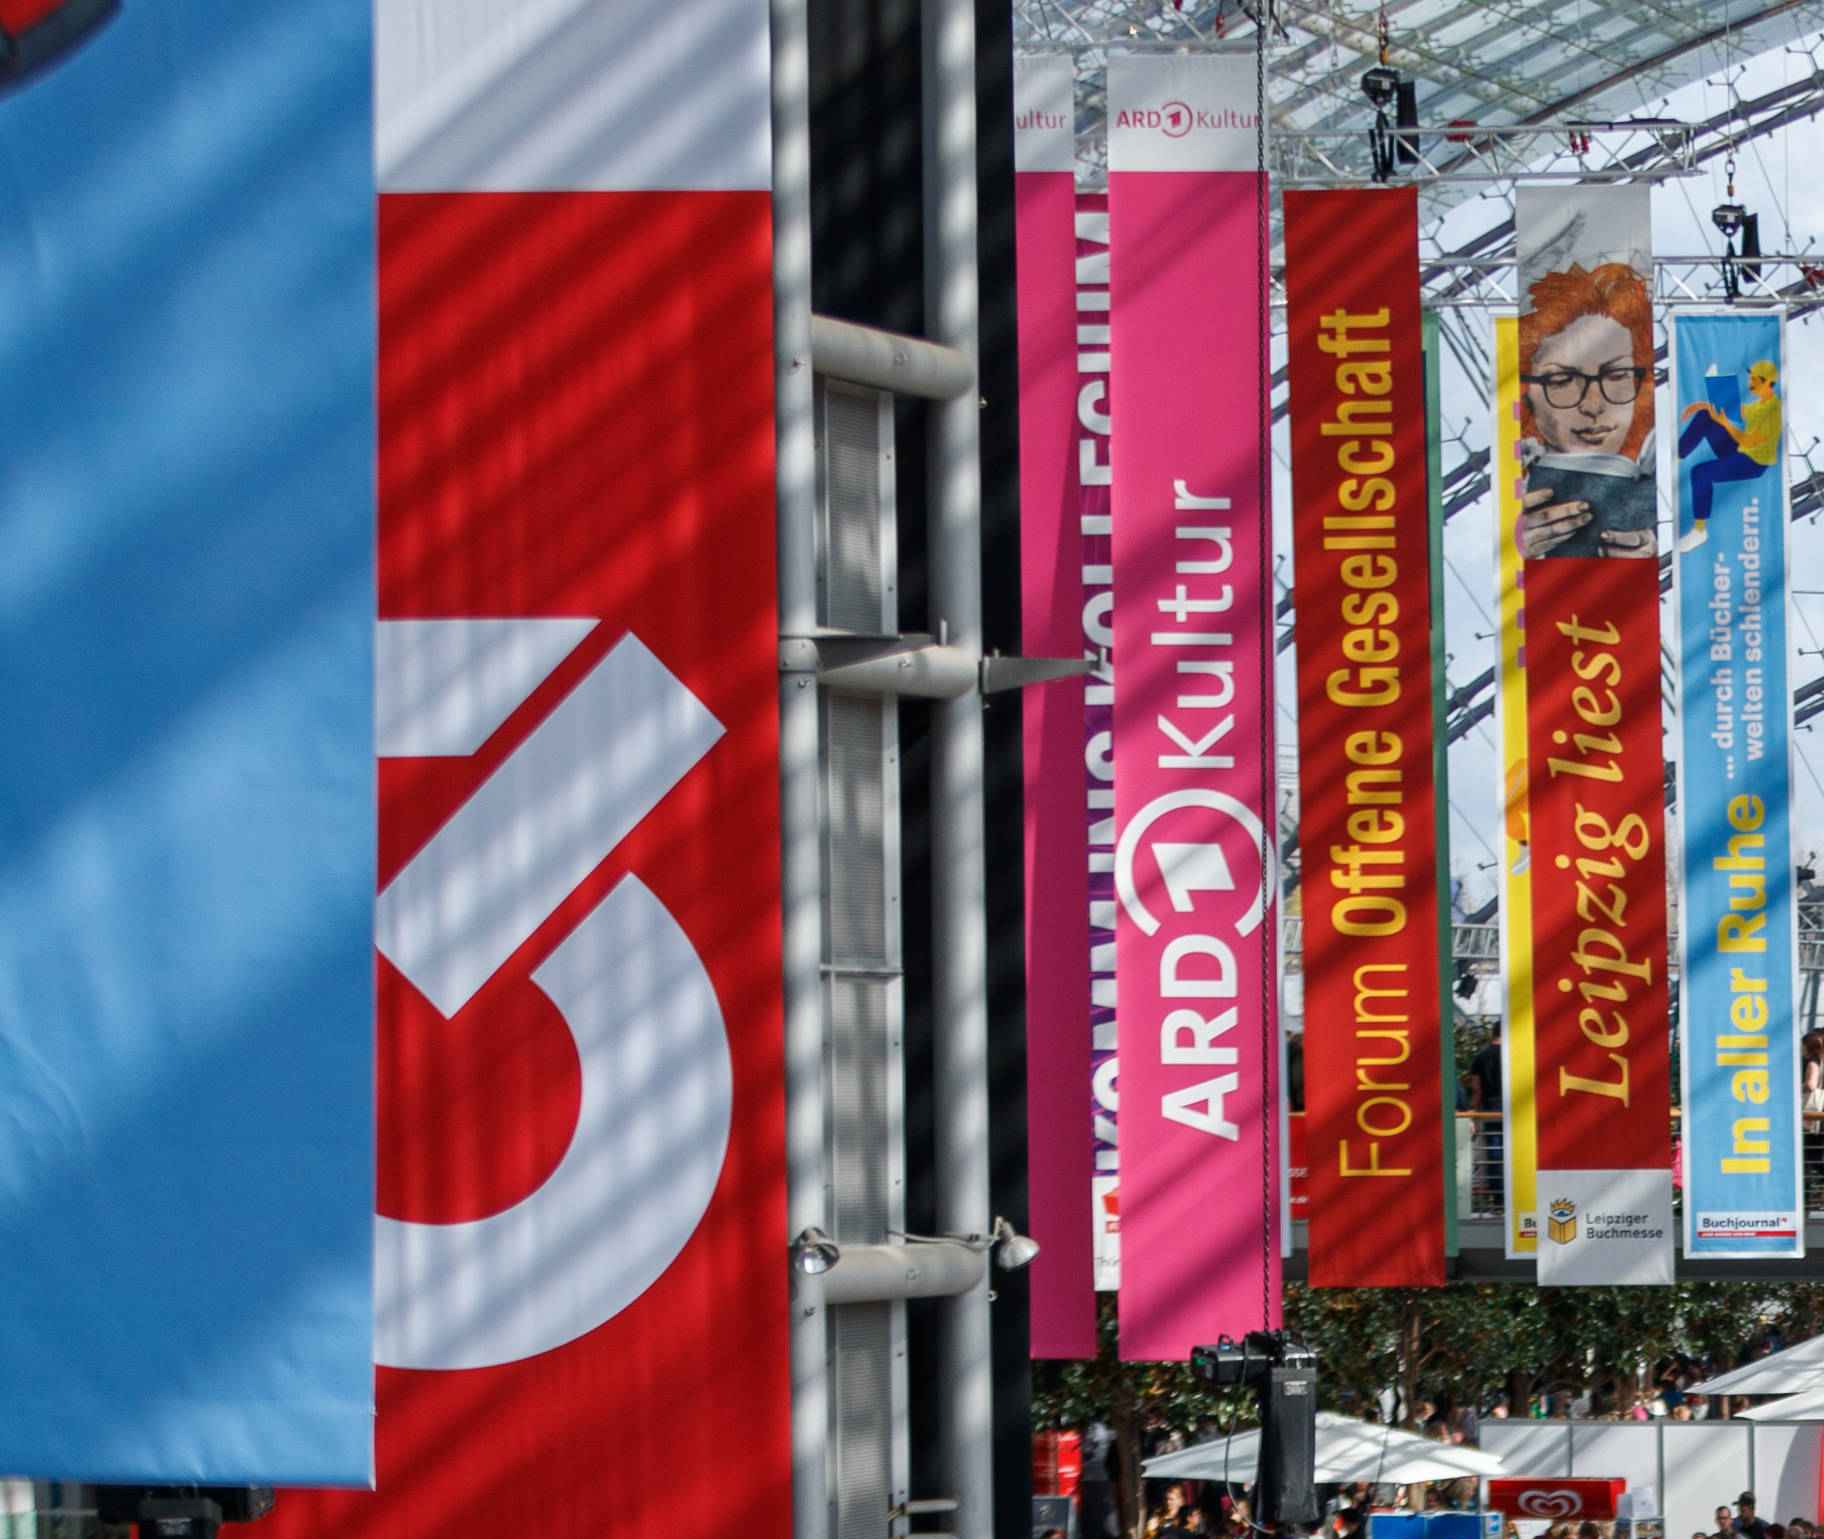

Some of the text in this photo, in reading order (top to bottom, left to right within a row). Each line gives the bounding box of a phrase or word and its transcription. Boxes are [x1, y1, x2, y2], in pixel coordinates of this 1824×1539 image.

[1016, 108, 1067, 130] ultur
[1115, 108, 1161, 130] ARD
[1197, 108, 1263, 130] Kultur
[1153, 480, 1236, 768] Kultur
[1710, 551, 1734, 662] Bücher-
[1737, 497, 1764, 761] welten schlendern.
[1317, 307, 1413, 1177] Forum Offene Gesellschaft
[1710, 668, 1735, 748] durch
[1546, 613, 1652, 1108] Leipzig liest
[1712, 793, 1767, 953] Ruhe
[1160, 934, 1239, 1142] ARD
[1716, 967, 1770, 1104] aller
[1721, 1118, 1771, 1175] In
[1586, 1213, 1648, 1226] Leipziger
[1586, 1227, 1663, 1239] Buchmesse
[1702, 1217, 1780, 1230] Buchjournal
